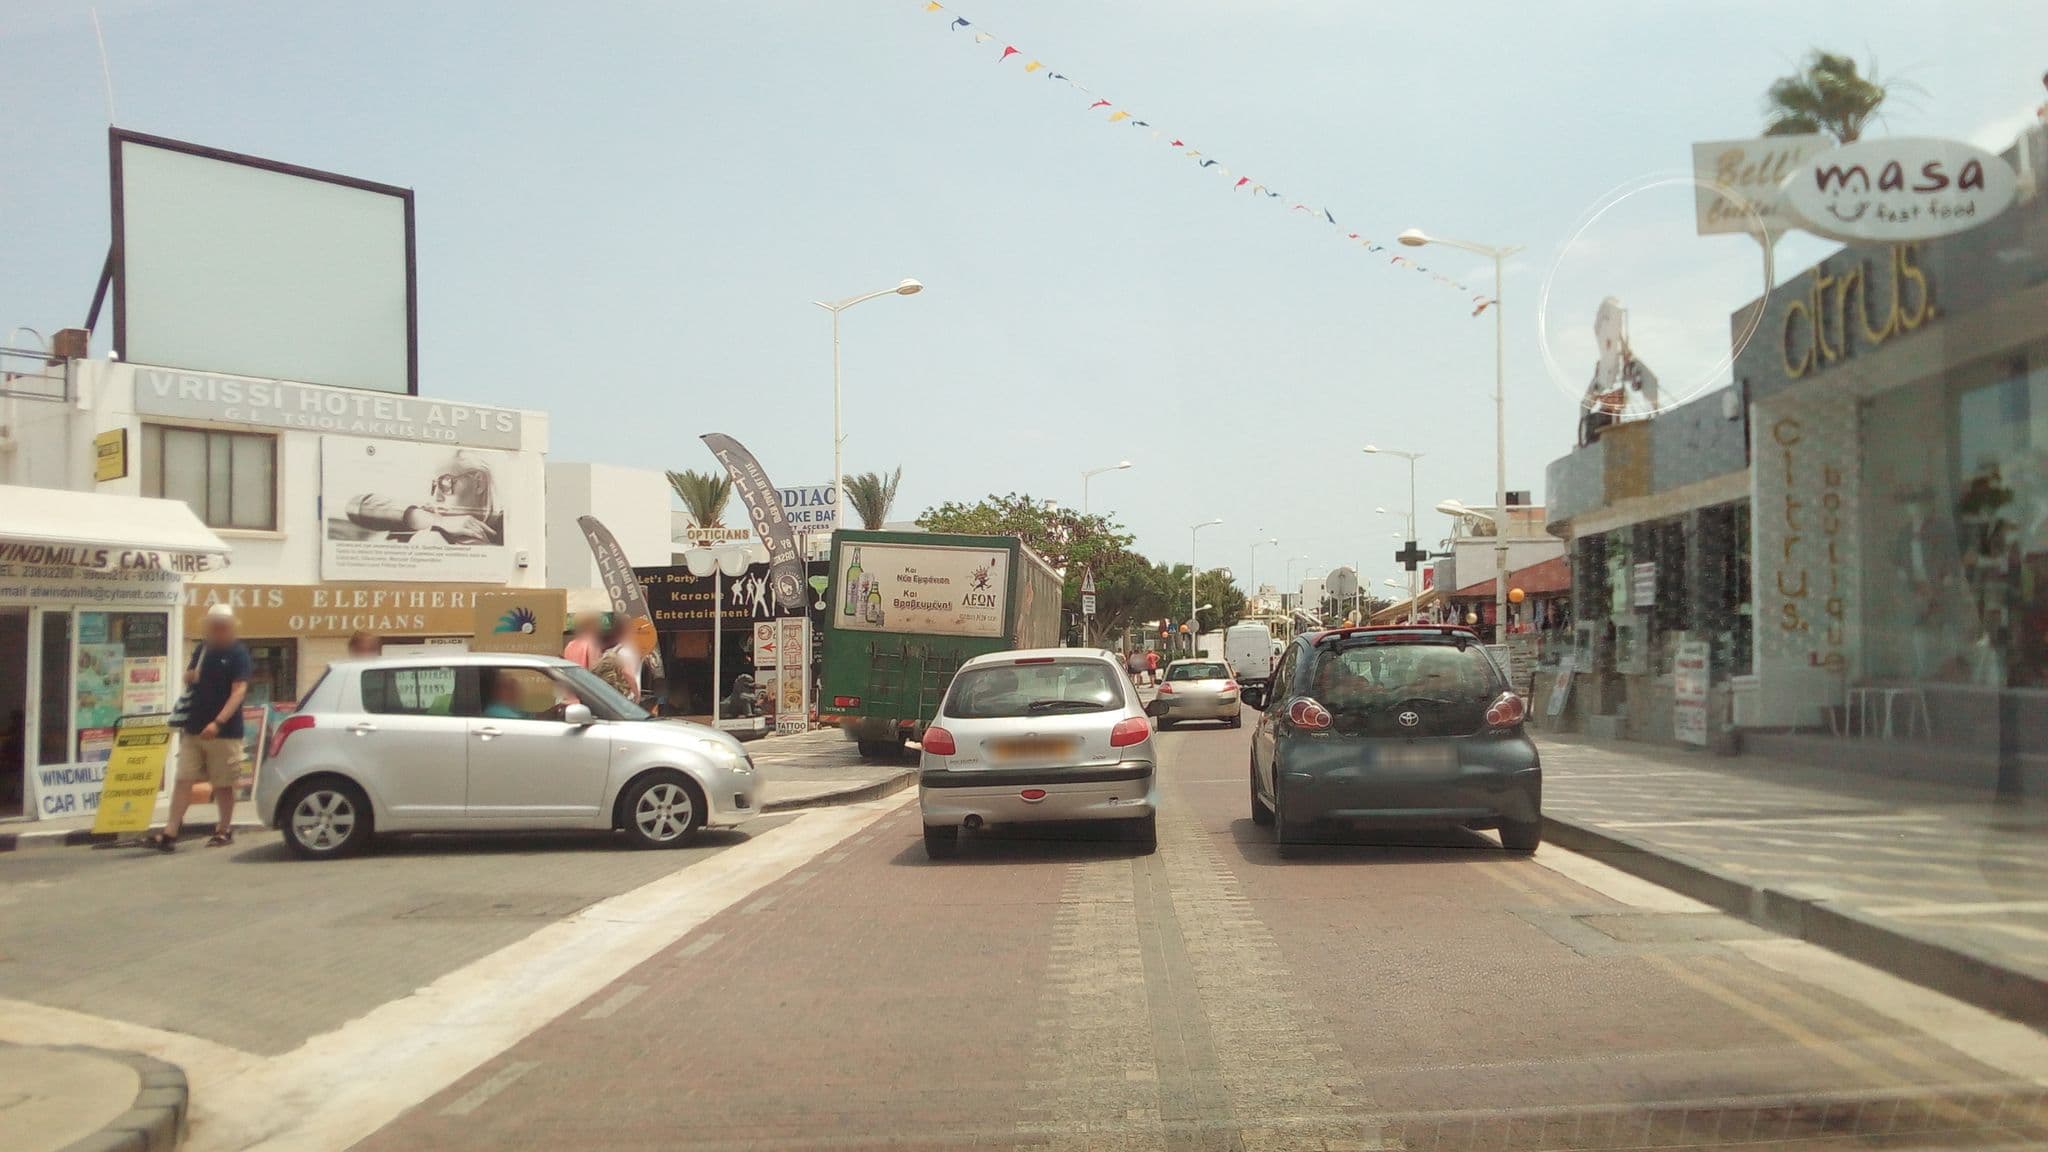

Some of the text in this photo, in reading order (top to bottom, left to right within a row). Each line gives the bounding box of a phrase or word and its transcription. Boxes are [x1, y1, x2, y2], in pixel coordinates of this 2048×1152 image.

[1815, 159, 1984, 194] masa
[148, 371, 514, 433] VRISSI HOTEL APTS
[283, 413, 413, 438] TSIOLAKKIS
[421, 427, 457, 441] LTD
[775, 487, 837, 508] DIAC
[785, 511, 811, 523] OKE
[687, 529, 750, 540] OPTICIANS
[119, 550, 162, 570] CAR
[169, 553, 210, 573] HIRE
[0, 565, 17, 578] EL
[638, 574, 662, 585] Let's
[180, 588, 516, 609] MAKIS ELEFTHERI
[671, 591, 725, 601] Karaoe
[903, 589, 918, 598] Και
[962, 593, 996, 608] ΛΕΩΝ
[289, 613, 426, 631] OPTICIANS
[777, 722, 806, 730] TATTOO
[42, 791, 103, 814] CAR HI
